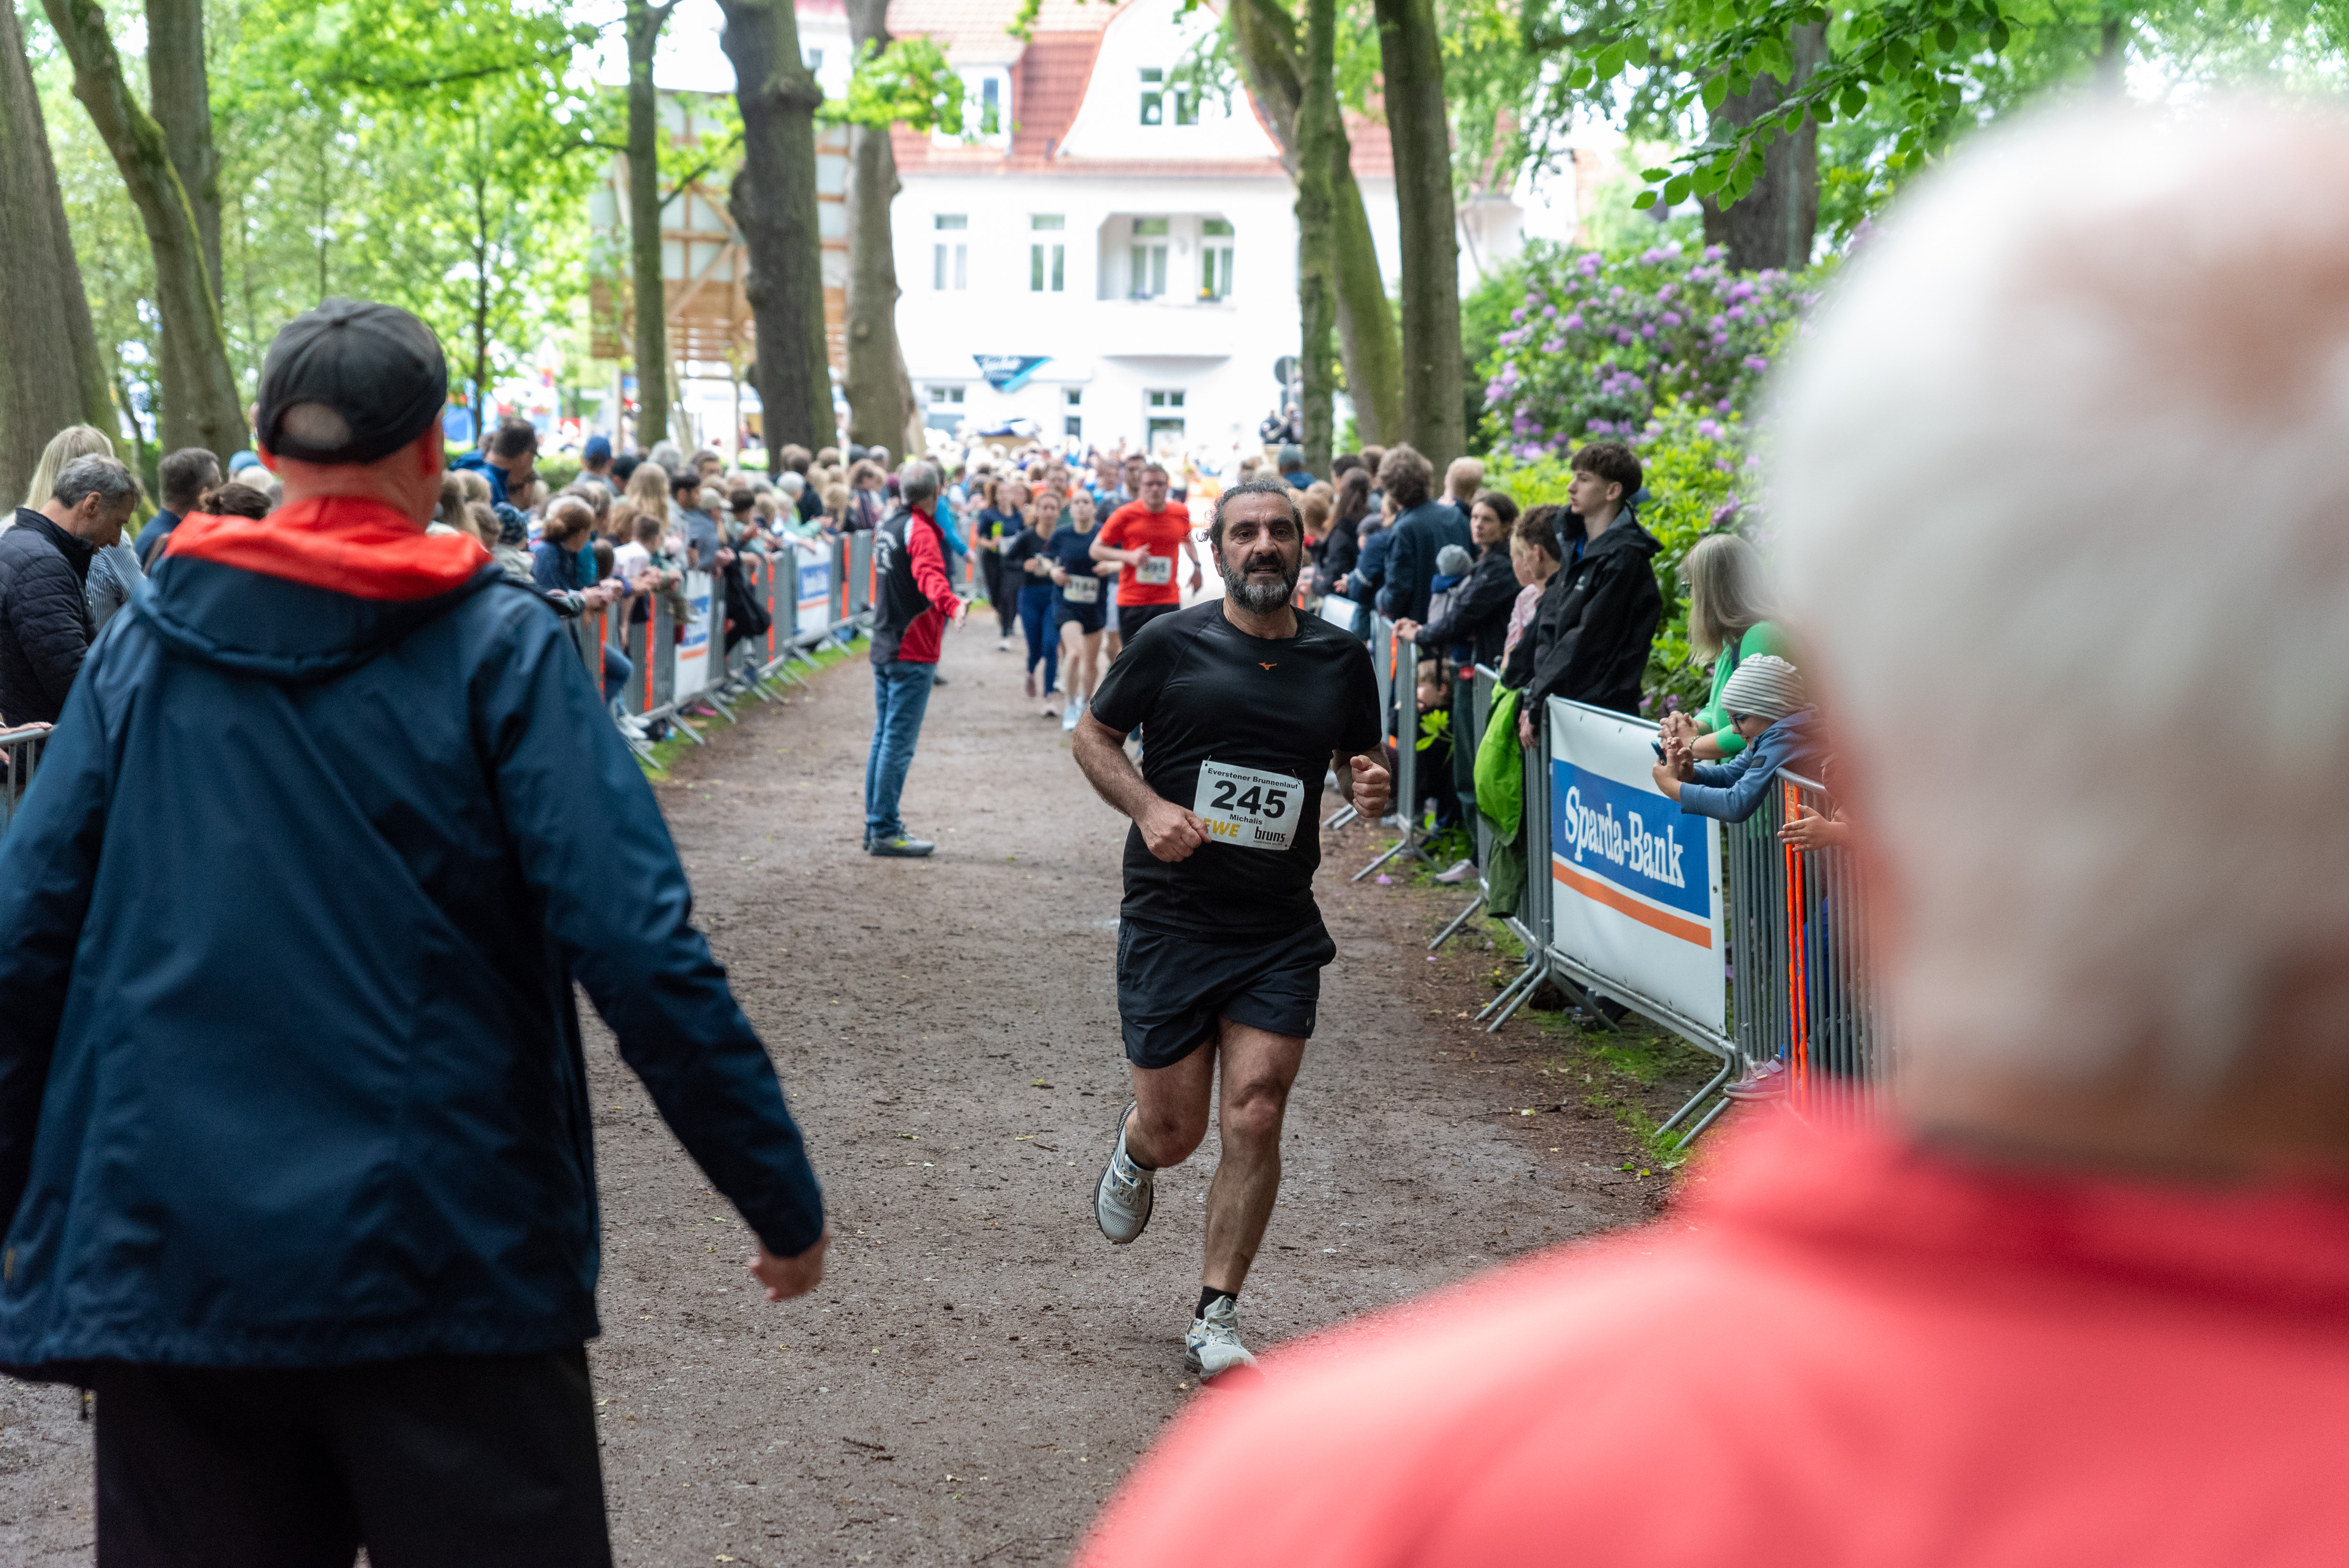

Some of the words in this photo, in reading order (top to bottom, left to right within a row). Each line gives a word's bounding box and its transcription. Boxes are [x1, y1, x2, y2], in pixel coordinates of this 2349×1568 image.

[1208, 768, 1251, 781] Everstener
[1253, 776, 1298, 789] Brunnenlauf
[1211, 780, 1288, 818] 245
[1229, 814, 1262, 825] Michalis
[1254, 826, 1286, 842] bruns
[1565, 786, 1684, 888] Sparda-Bank
